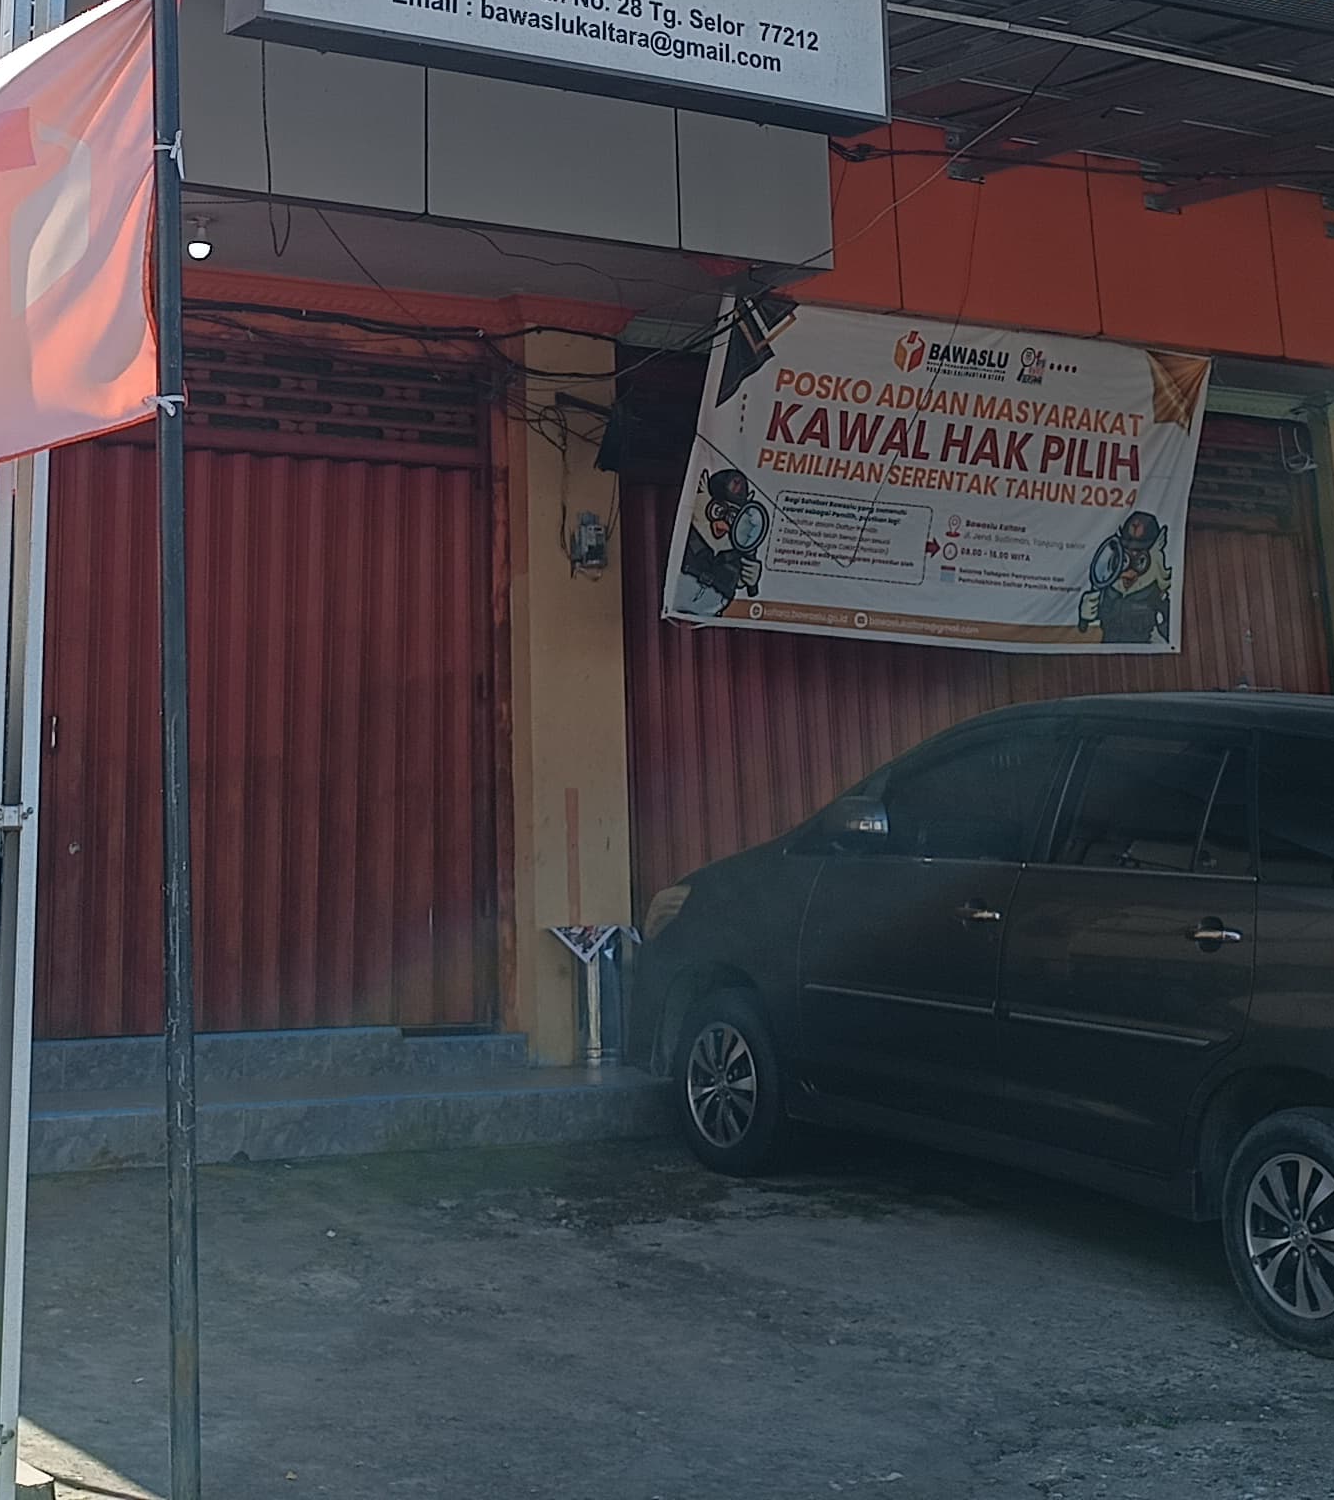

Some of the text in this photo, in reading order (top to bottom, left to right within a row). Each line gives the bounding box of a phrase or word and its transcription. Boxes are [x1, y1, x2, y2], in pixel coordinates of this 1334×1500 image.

[649, 0, 683, 29] Tg.
[689, 8, 745, 38] Selor
[759, 21, 820, 52] 77212
[928, 343, 1010, 368] BAWASLU
[774, 368, 1144, 437] POSKO ADUAN MASYARAKAT
[766, 401, 1140, 482] KAWAL HAK PILIH
[757, 448, 1138, 509] PEMILIHAN SERENTAK TAHUN 2024
